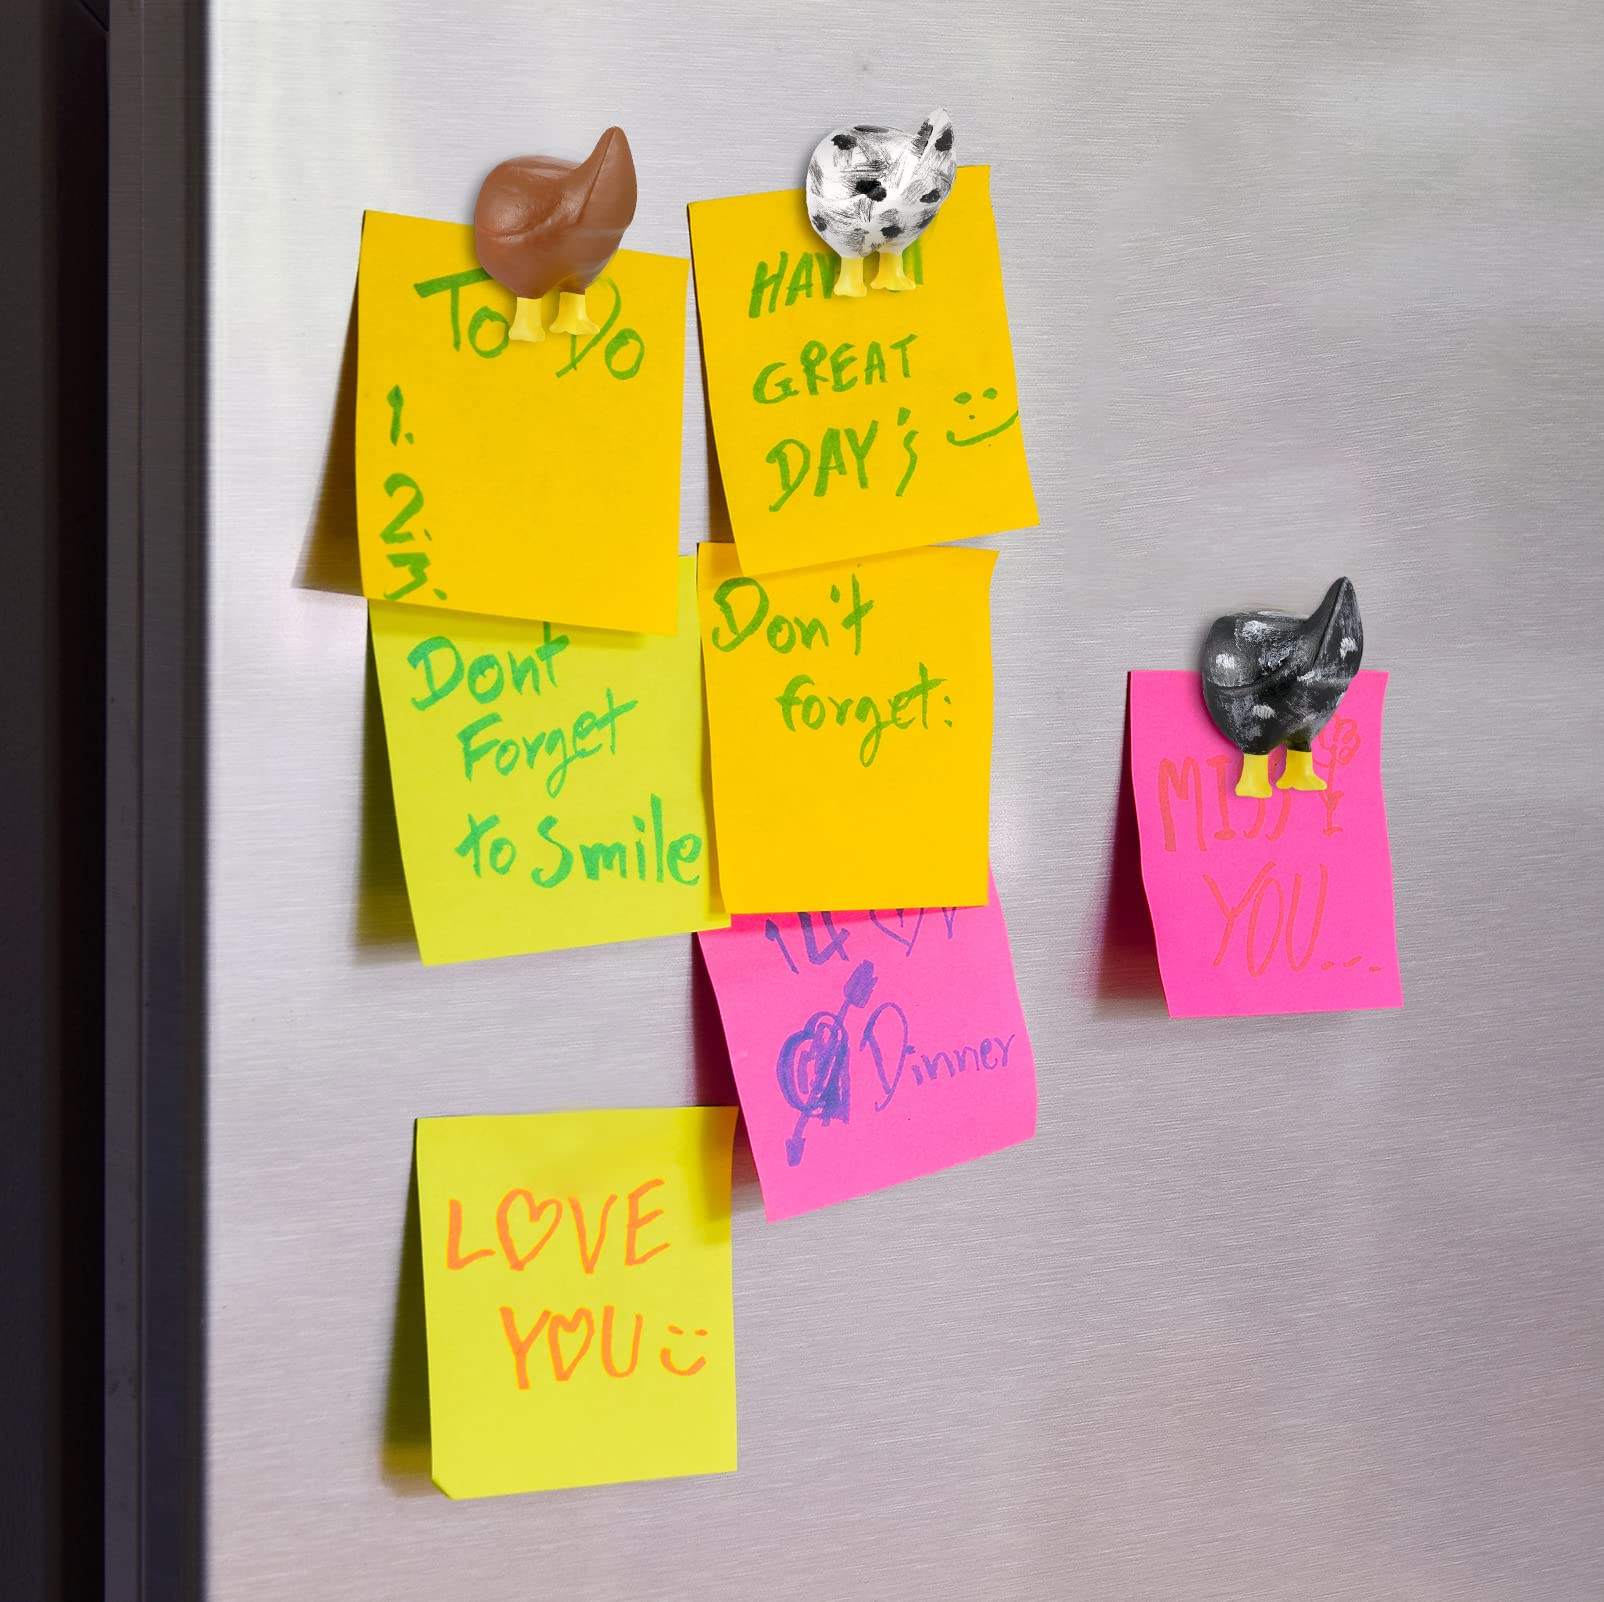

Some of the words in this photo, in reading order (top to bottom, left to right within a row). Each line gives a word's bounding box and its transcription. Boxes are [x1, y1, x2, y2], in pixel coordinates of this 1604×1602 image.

[413, 266, 511, 358] To
[748, 250, 843, 319] HAV
[752, 334, 918, 404] GREAT
[386, 385, 415, 446] 1.
[379, 473, 432, 544] 2.
[383, 552, 448, 601] 3.
[711, 573, 875, 656] Don't
[456, 687, 639, 799] Forget
[774, 661, 953, 768] forget:
[454, 813, 517, 878] to
[859, 1001, 1016, 1112] Dinner
